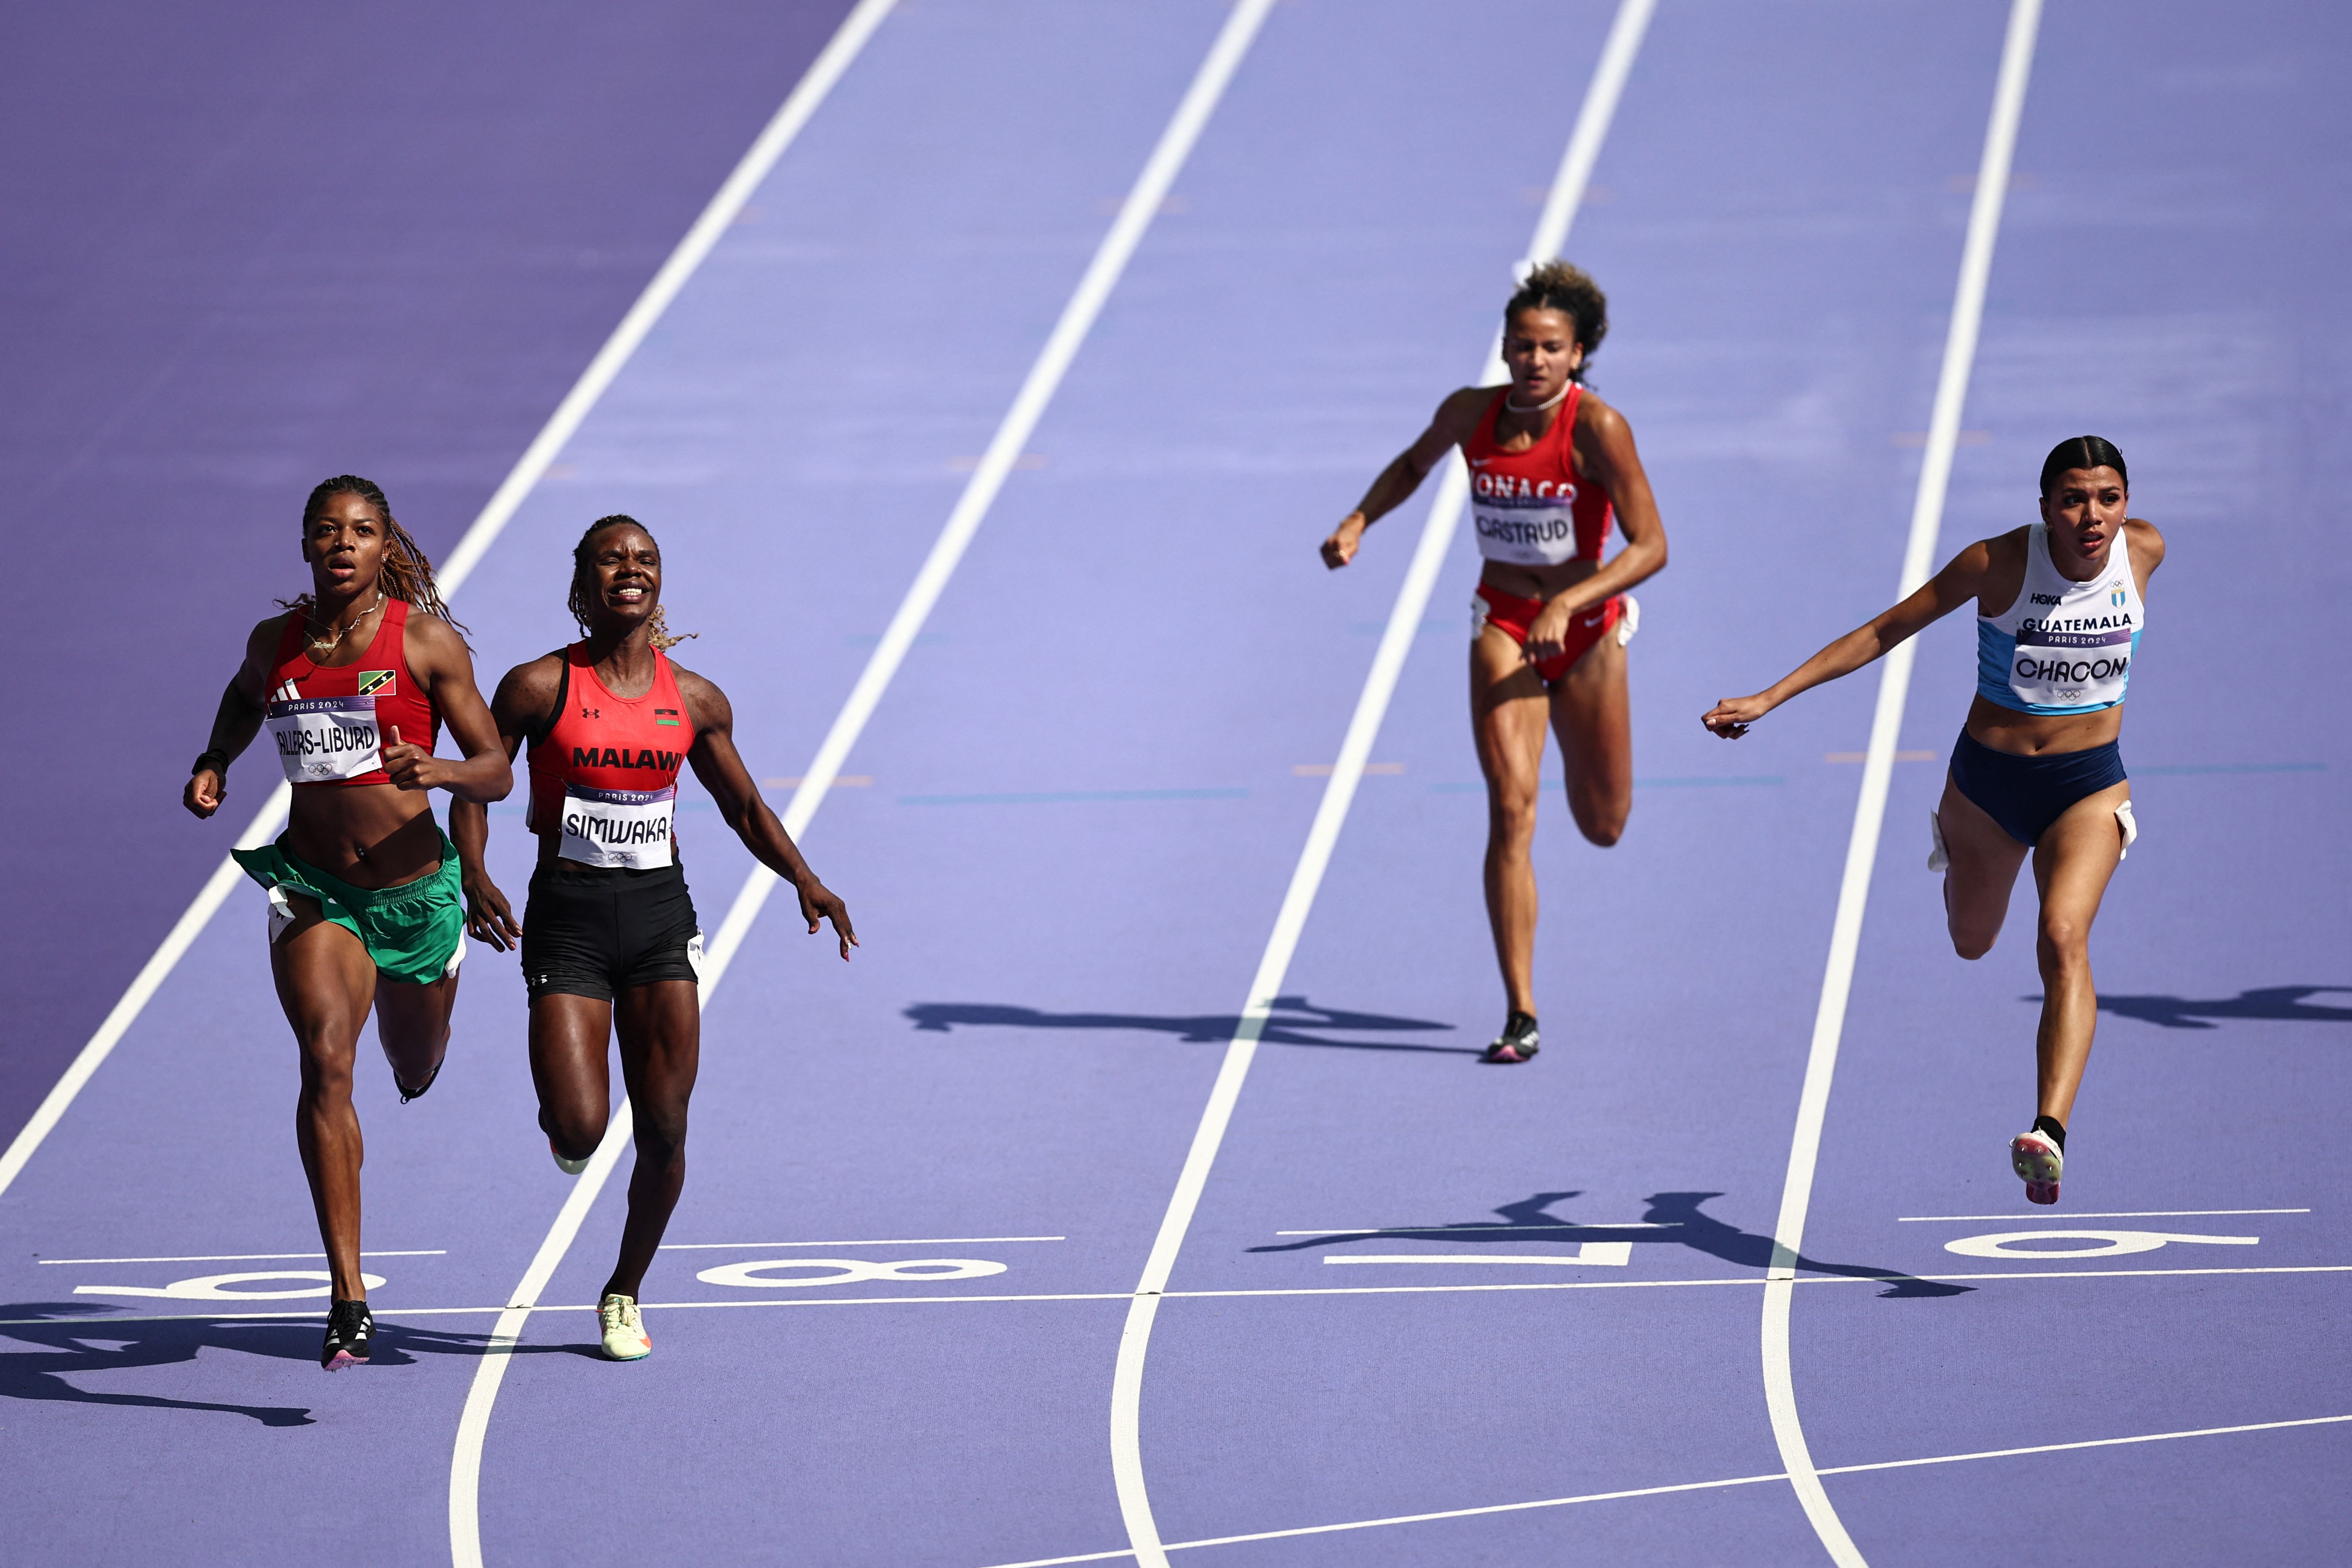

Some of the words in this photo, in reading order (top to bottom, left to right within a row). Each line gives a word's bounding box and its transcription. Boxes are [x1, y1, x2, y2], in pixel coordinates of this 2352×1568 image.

[1469, 469, 1578, 503] ONACO
[1476, 515, 1567, 543] GASTAUD
[2030, 593, 2061, 605] HOKA
[2022, 613, 2132, 632] GUATEMALA
[2016, 657, 2127, 682] CHACON
[276, 726, 374, 755] ALLERS-LIBURD
[566, 814, 666, 844] SIMWAKA
[696, 1258, 1007, 1288] 8
